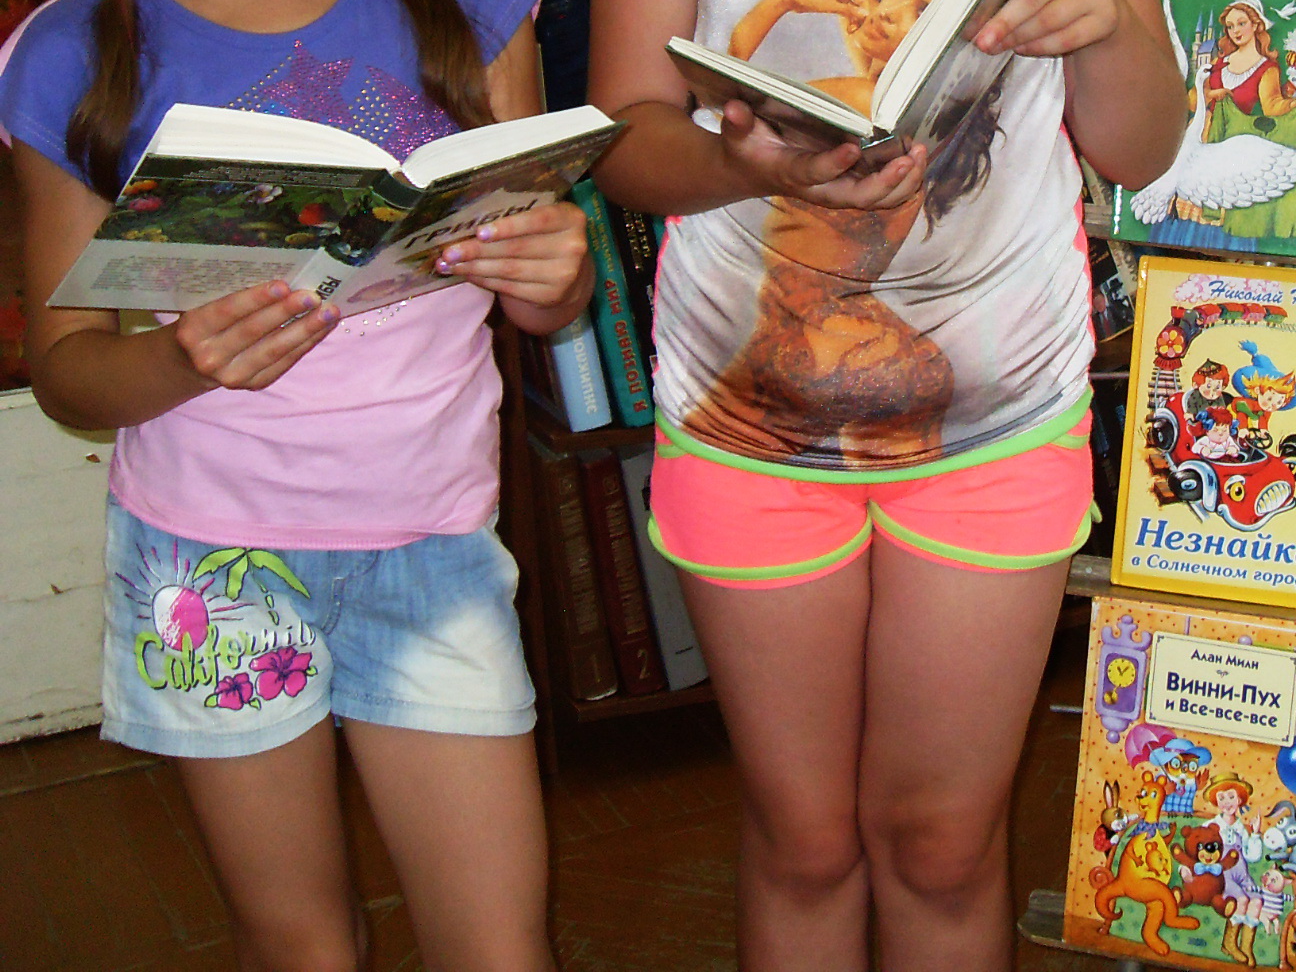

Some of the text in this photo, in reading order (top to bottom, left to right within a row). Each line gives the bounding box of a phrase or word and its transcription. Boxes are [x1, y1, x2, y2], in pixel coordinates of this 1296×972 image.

[404, 198, 538, 249] ГРИБЫ
[1208, 280, 1283, 304] Николай
[603, 277, 648, 413] Я ПОЗНАЮ МИР
[1131, 556, 1141, 566] в
[1146, 554, 1247, 579] Солнечном
[1190, 649, 1260, 670] Алан Милн
[1165, 697, 1278, 728] и Все-все-все
